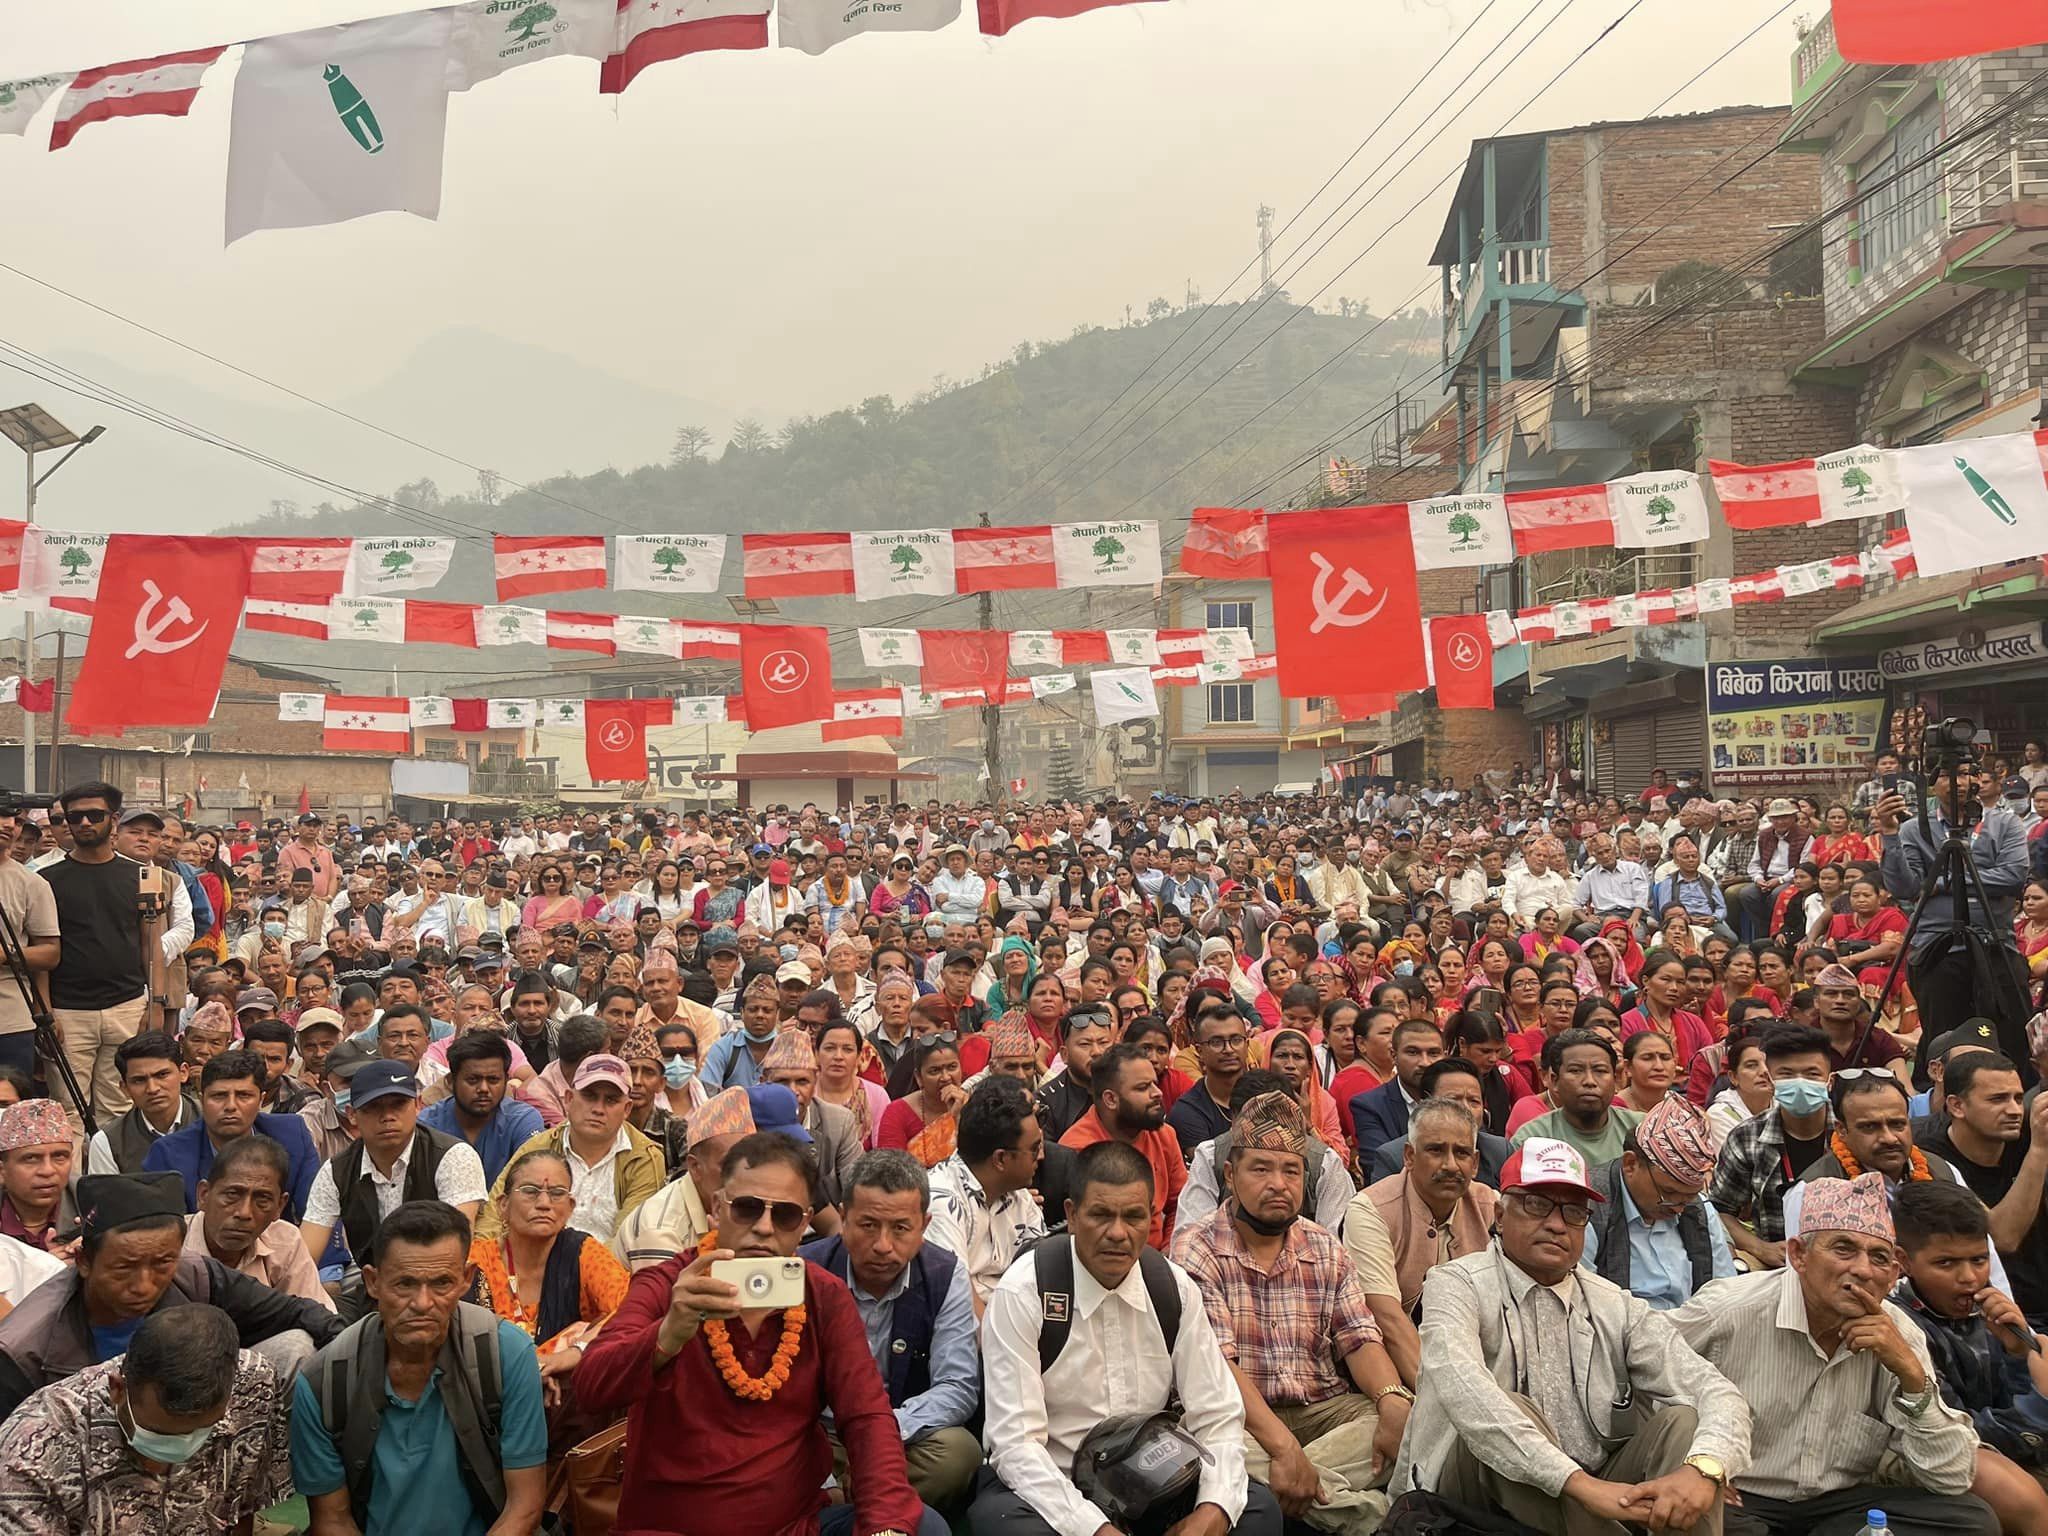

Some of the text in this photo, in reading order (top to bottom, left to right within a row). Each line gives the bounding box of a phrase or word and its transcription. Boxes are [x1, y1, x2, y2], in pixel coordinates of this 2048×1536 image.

[1985, 634, 2037, 660] पसल
[1716, 665, 1884, 696] बिबेक किराना पसल
